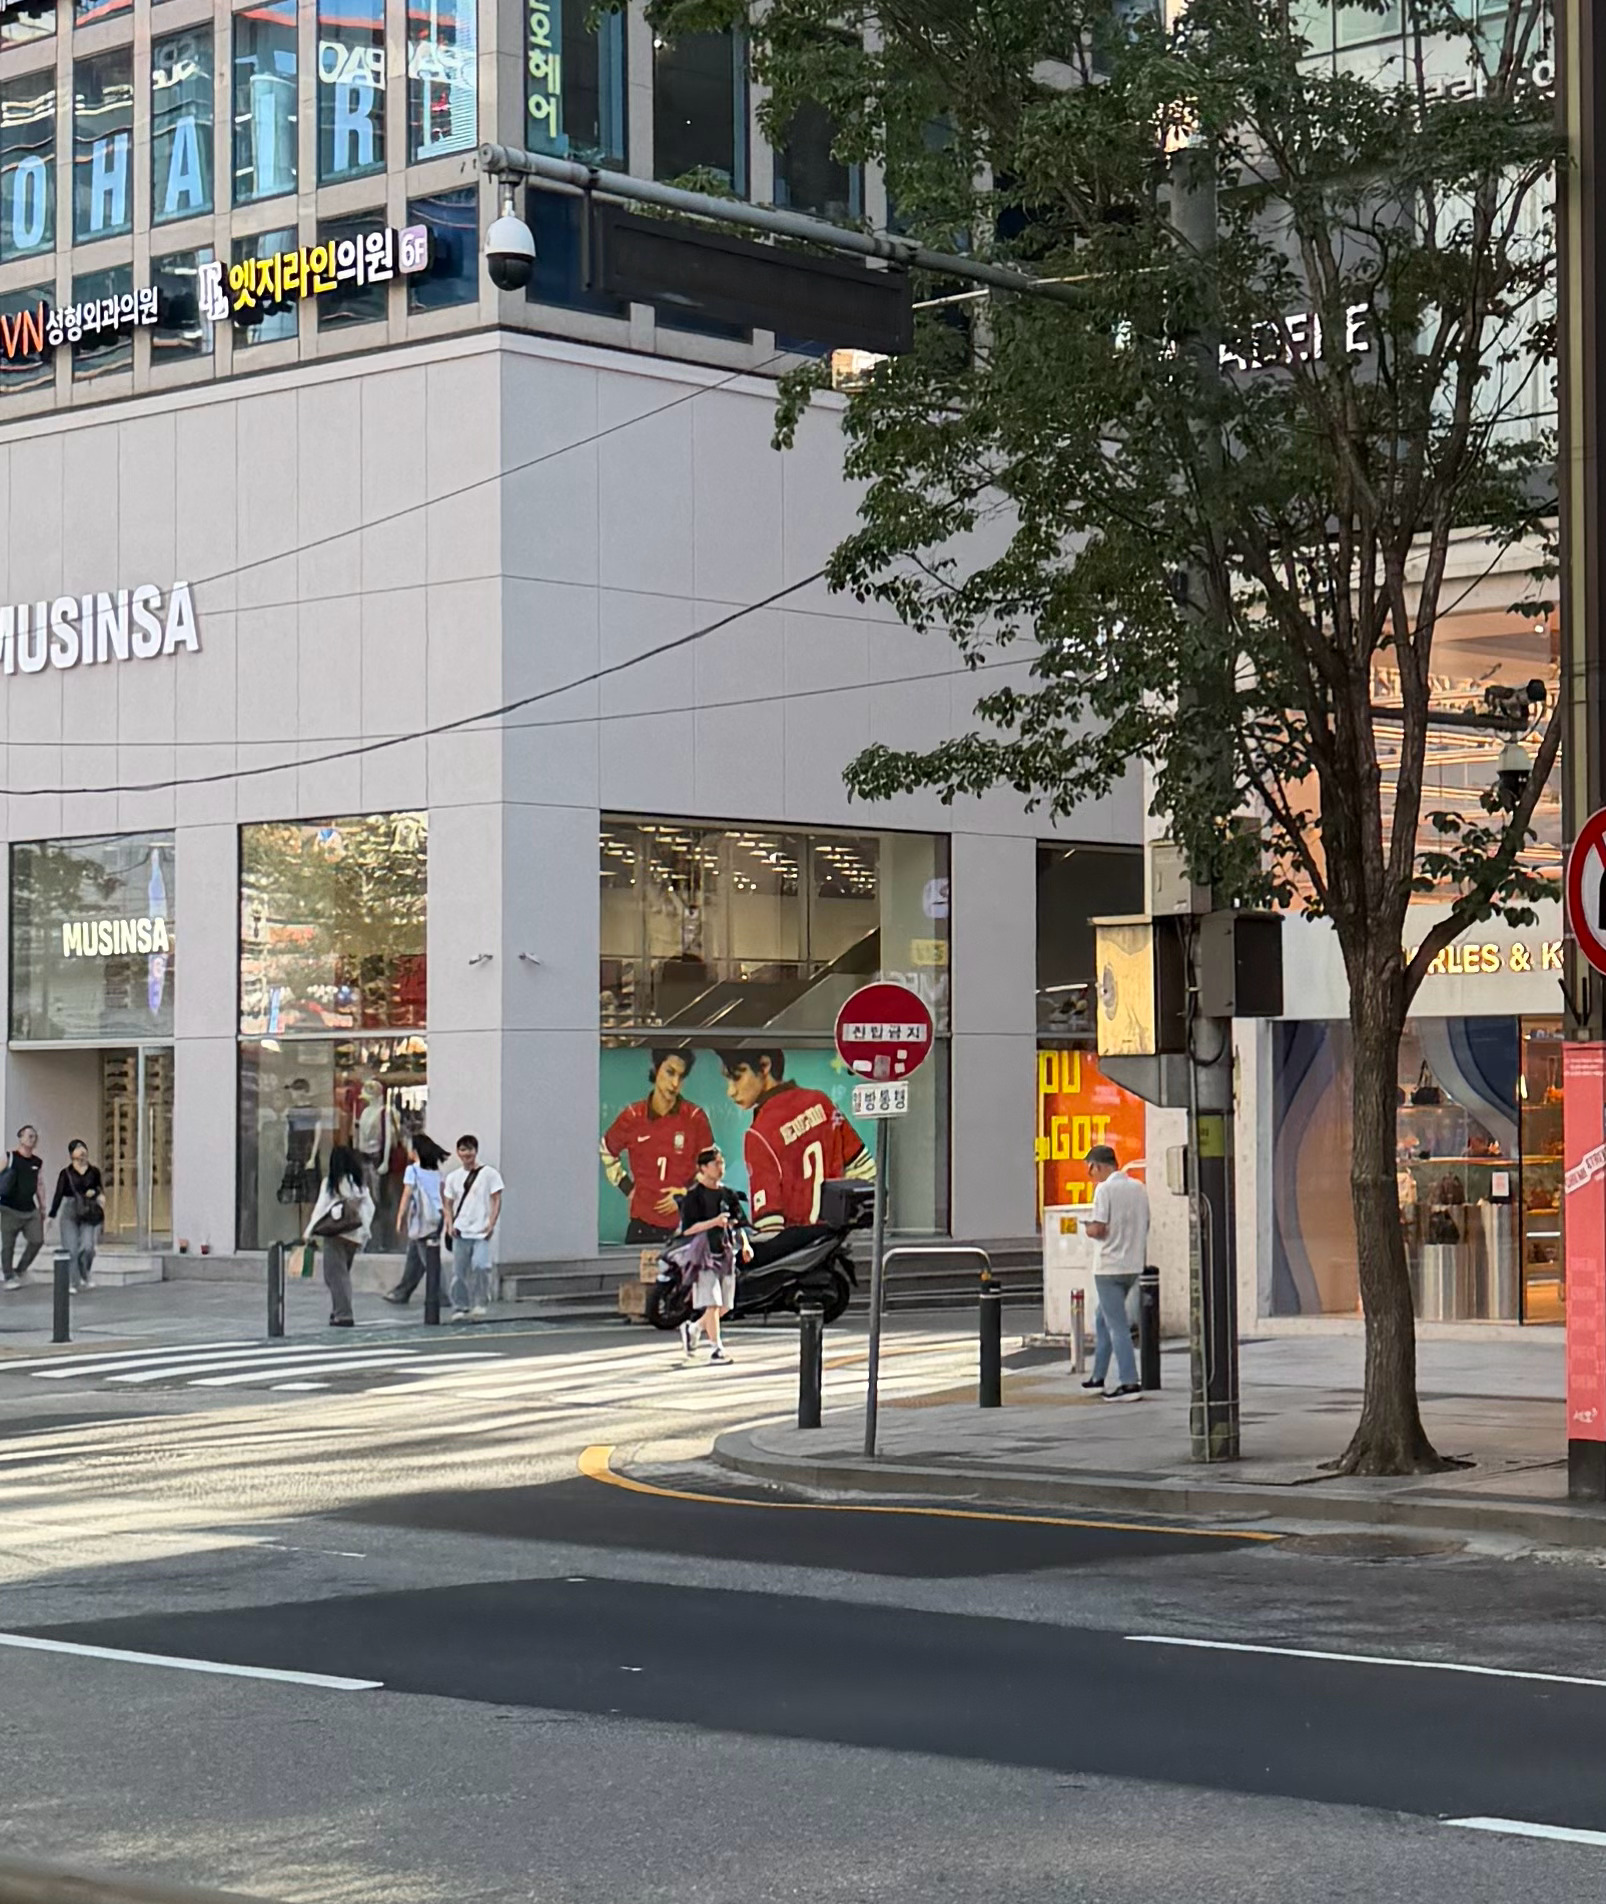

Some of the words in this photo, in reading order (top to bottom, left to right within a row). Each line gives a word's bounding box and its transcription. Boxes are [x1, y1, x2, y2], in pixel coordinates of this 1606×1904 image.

[230, 228, 393, 311] 엣지라인의원
[401, 234, 425, 267] 6F
[62, 917, 169, 957] MUSINSA
[1402, 943, 1500, 974] RLES
[1510, 943, 1531, 972] &
[853, 1025, 920, 1040] 진입금지
[1051, 1115, 1110, 1160] GOT
